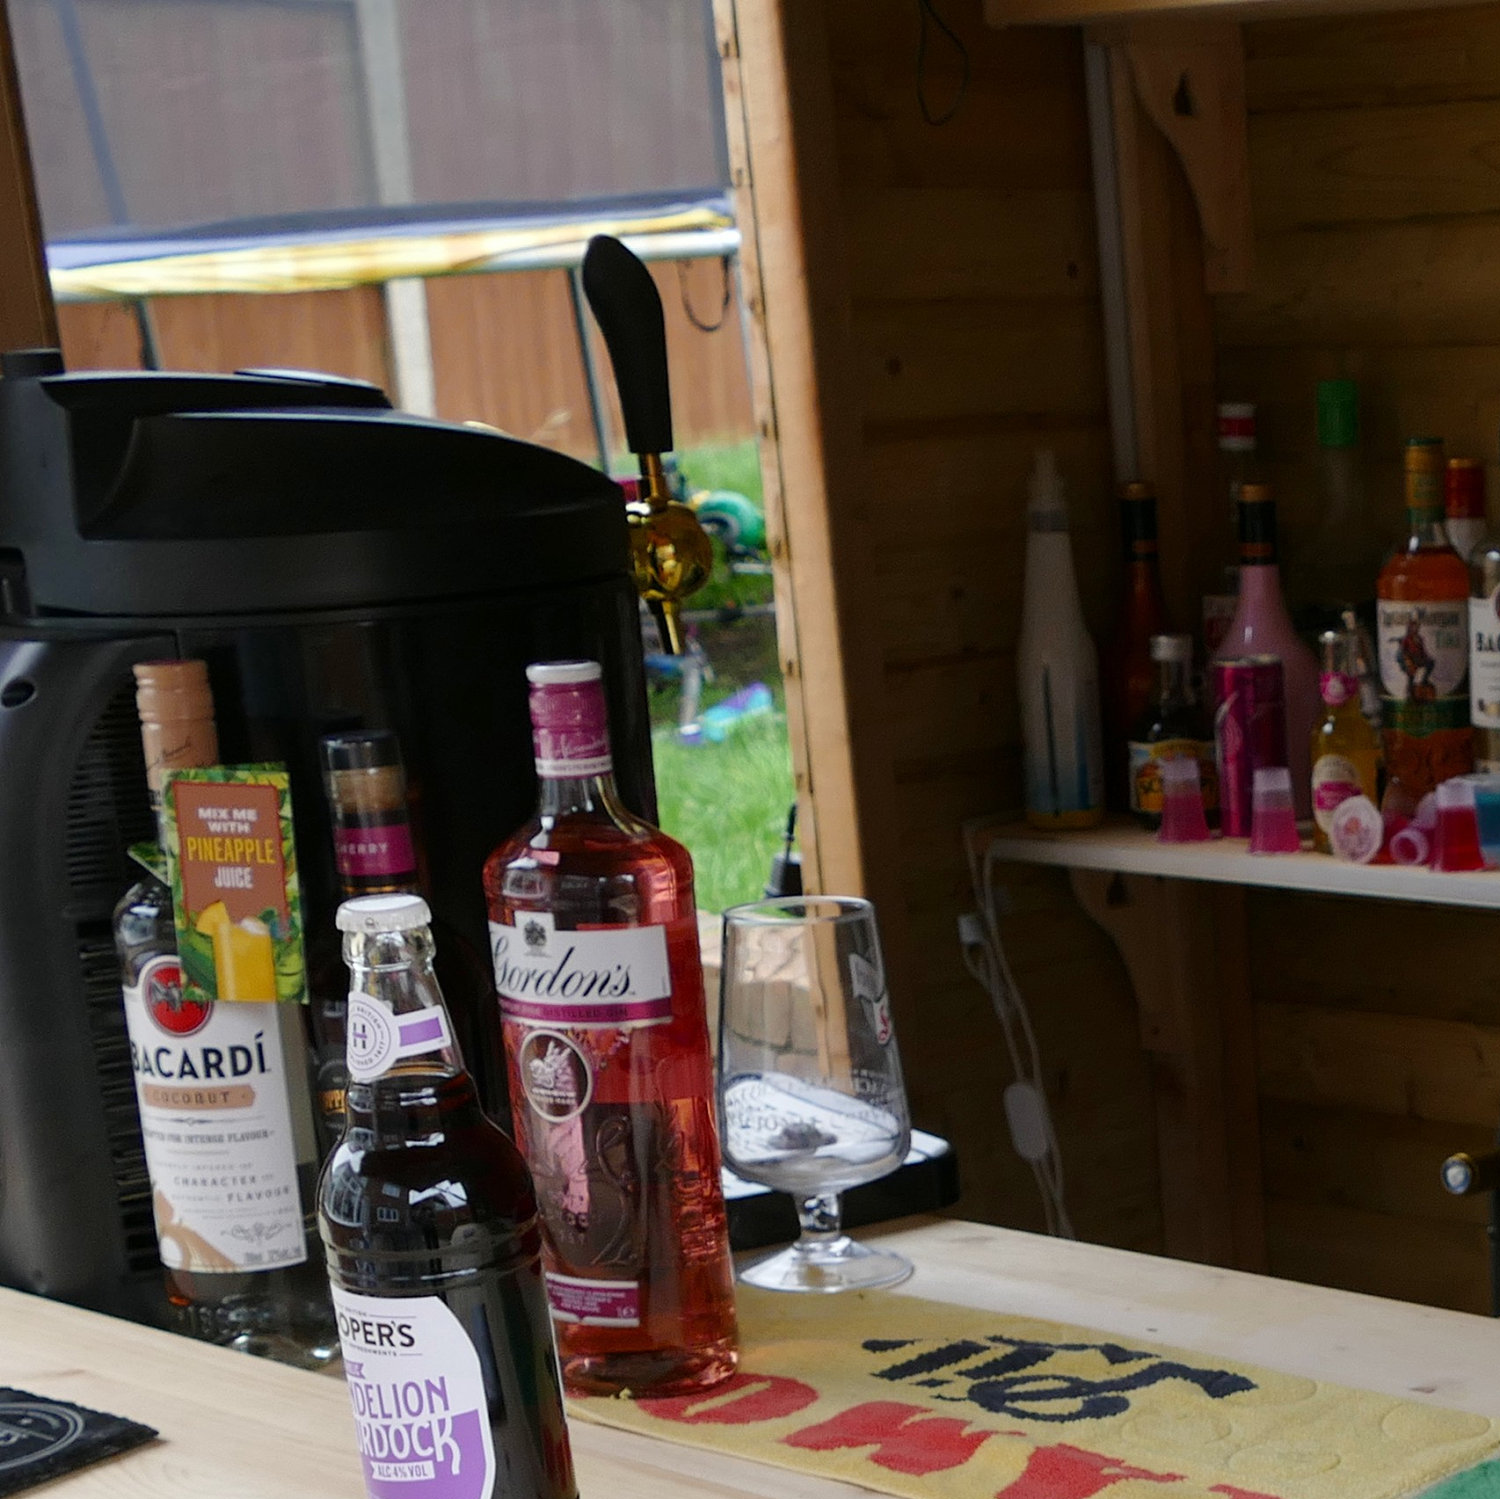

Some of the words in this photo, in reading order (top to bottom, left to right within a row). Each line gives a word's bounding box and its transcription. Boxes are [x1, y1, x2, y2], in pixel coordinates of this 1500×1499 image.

[197, 808, 229, 820] MIX
[232, 808, 258, 822] ME
[207, 821, 251, 833] WITH
[186, 836, 277, 864] PINEAPPLE
[214, 866, 254, 889] JUICE
[494, 936, 632, 998] Gordon's
[131, 1030, 268, 1080] BACARDÍ
[227, 1130, 269, 1143] FLAVOUR
[338, 1312, 415, 1348] OPER'S
[351, 1376, 450, 1419] DELION
[357, 1416, 461, 1475] RDOCK
[377, 1465, 391, 1478] ALC
[409, 1463, 428, 1477] VOL
